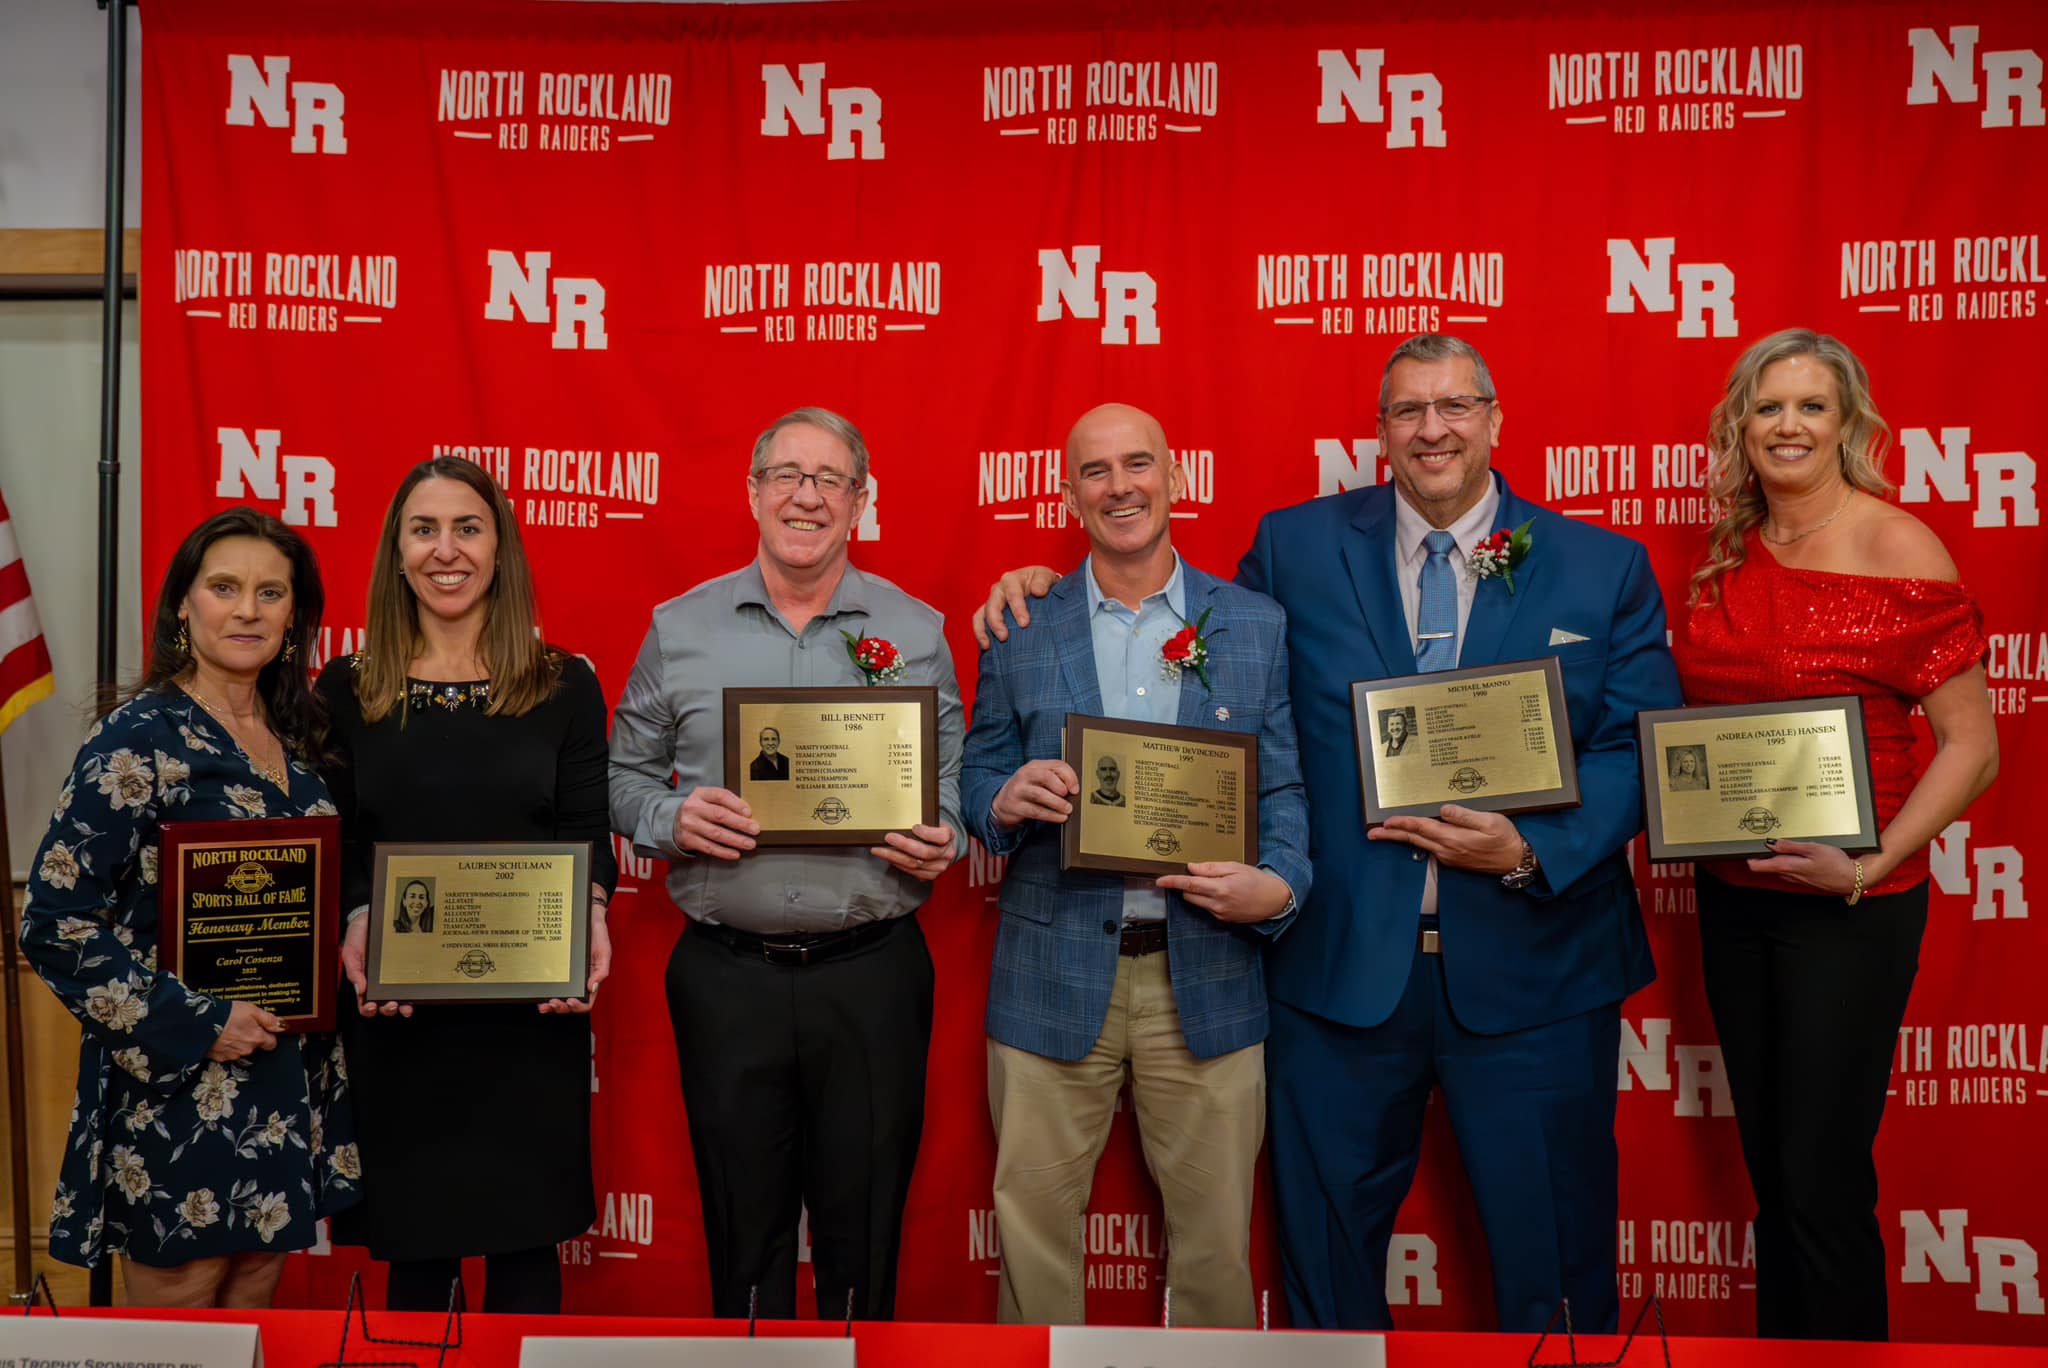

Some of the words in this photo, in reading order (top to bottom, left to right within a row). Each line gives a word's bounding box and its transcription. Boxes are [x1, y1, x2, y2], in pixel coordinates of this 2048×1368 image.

[984, 65, 1071, 121] NORTH
[1086, 61, 1217, 118] ROCKLAND
[1549, 52, 1639, 110] NORTH
[1655, 45, 1802, 99] ROCKLAND
[1907, 26, 2045, 128] NR
[226, 54, 347, 154] NR
[438, 69, 527, 121] NORTH
[538, 73, 671, 126] ROCKLAND
[761, 63, 885, 160] NR
[1317, 49, 1446, 149] NR
[1048, 118, 1077, 144] RED
[1087, 114, 1156, 141] RAIDERS
[1615, 106, 1645, 133] RED
[1659, 102, 1734, 132] RAIDERS
[499, 123, 528, 150] RED
[540, 124, 610, 151] RAIDERS
[175, 250, 252, 304] NORTH
[265, 253, 397, 310] ROCKLAND
[1258, 255, 1347, 310] NORTH
[1363, 252, 1503, 308] ROCKLAND
[1841, 240, 1936, 300] NORTH
[485, 250, 608, 349] NR
[704, 264, 790, 317] NORTH
[804, 262, 940, 315] ROCKLAND
[1037, 245, 1160, 345] NR
[1607, 237, 1738, 338] NR
[229, 303, 256, 329] RED
[267, 304, 337, 332] RAIDERS
[1322, 307, 1352, 334] RED
[1366, 306, 1439, 334] RAIDERS
[1909, 294, 1942, 321] RED
[1957, 290, 2035, 320] RAIDERS
[765, 316, 794, 342] RED
[807, 314, 877, 341] RAIDERS
[216, 427, 338, 527] NR
[524, 448, 659, 505] ROCKLAND
[979, 450, 1061, 506] NORTH
[1314, 439, 1392, 498] N
[1546, 445, 1635, 501] NORTH
[1899, 427, 2039, 528] NR
[526, 499, 598, 528] RAIDERS
[1036, 502, 1067, 528] RED
[1612, 499, 1642, 525] RED
[1448, 685, 1481, 693] MICHAEL
[1483, 680, 1510, 689] MANNO
[821, 713, 841, 722] BILL
[843, 713, 886, 721] BENNETT
[1716, 730, 1754, 741] ANDREA
[1754, 728, 1797, 739] (NATALE)
[1798, 725, 1836, 735] HANSEN
[1143, 742, 1180, 753] MATTHEW
[1767, 737, 1786, 746] 1995
[192, 850, 237, 869] NORTH
[240, 848, 307, 864] ROCKLAND
[458, 862, 497, 870] LAUREN
[499, 862, 552, 870] SCHULMAN
[495, 872, 514, 880] 2002
[192, 892, 233, 908] SPORTS
[235, 892, 261, 906] HALL
[263, 891, 277, 901] OF
[278, 886, 306, 903] FAME
[188, 922, 255, 935] Honorary
[257, 916, 310, 931] Member
[216, 957, 243, 967] Carol
[244, 955, 283, 965] Cosenza
[1906, 1080, 1938, 1106] RED
[1951, 1077, 2026, 1105] RAIDERS
[1651, 1220, 1756, 1269] ROCKLA
[1087, 1264, 1147, 1290] AIDERS
[1900, 1209, 2045, 1314] NR
[1617, 1272, 1643, 1298] ED
[1654, 1273, 1730, 1299] RAIDERS
